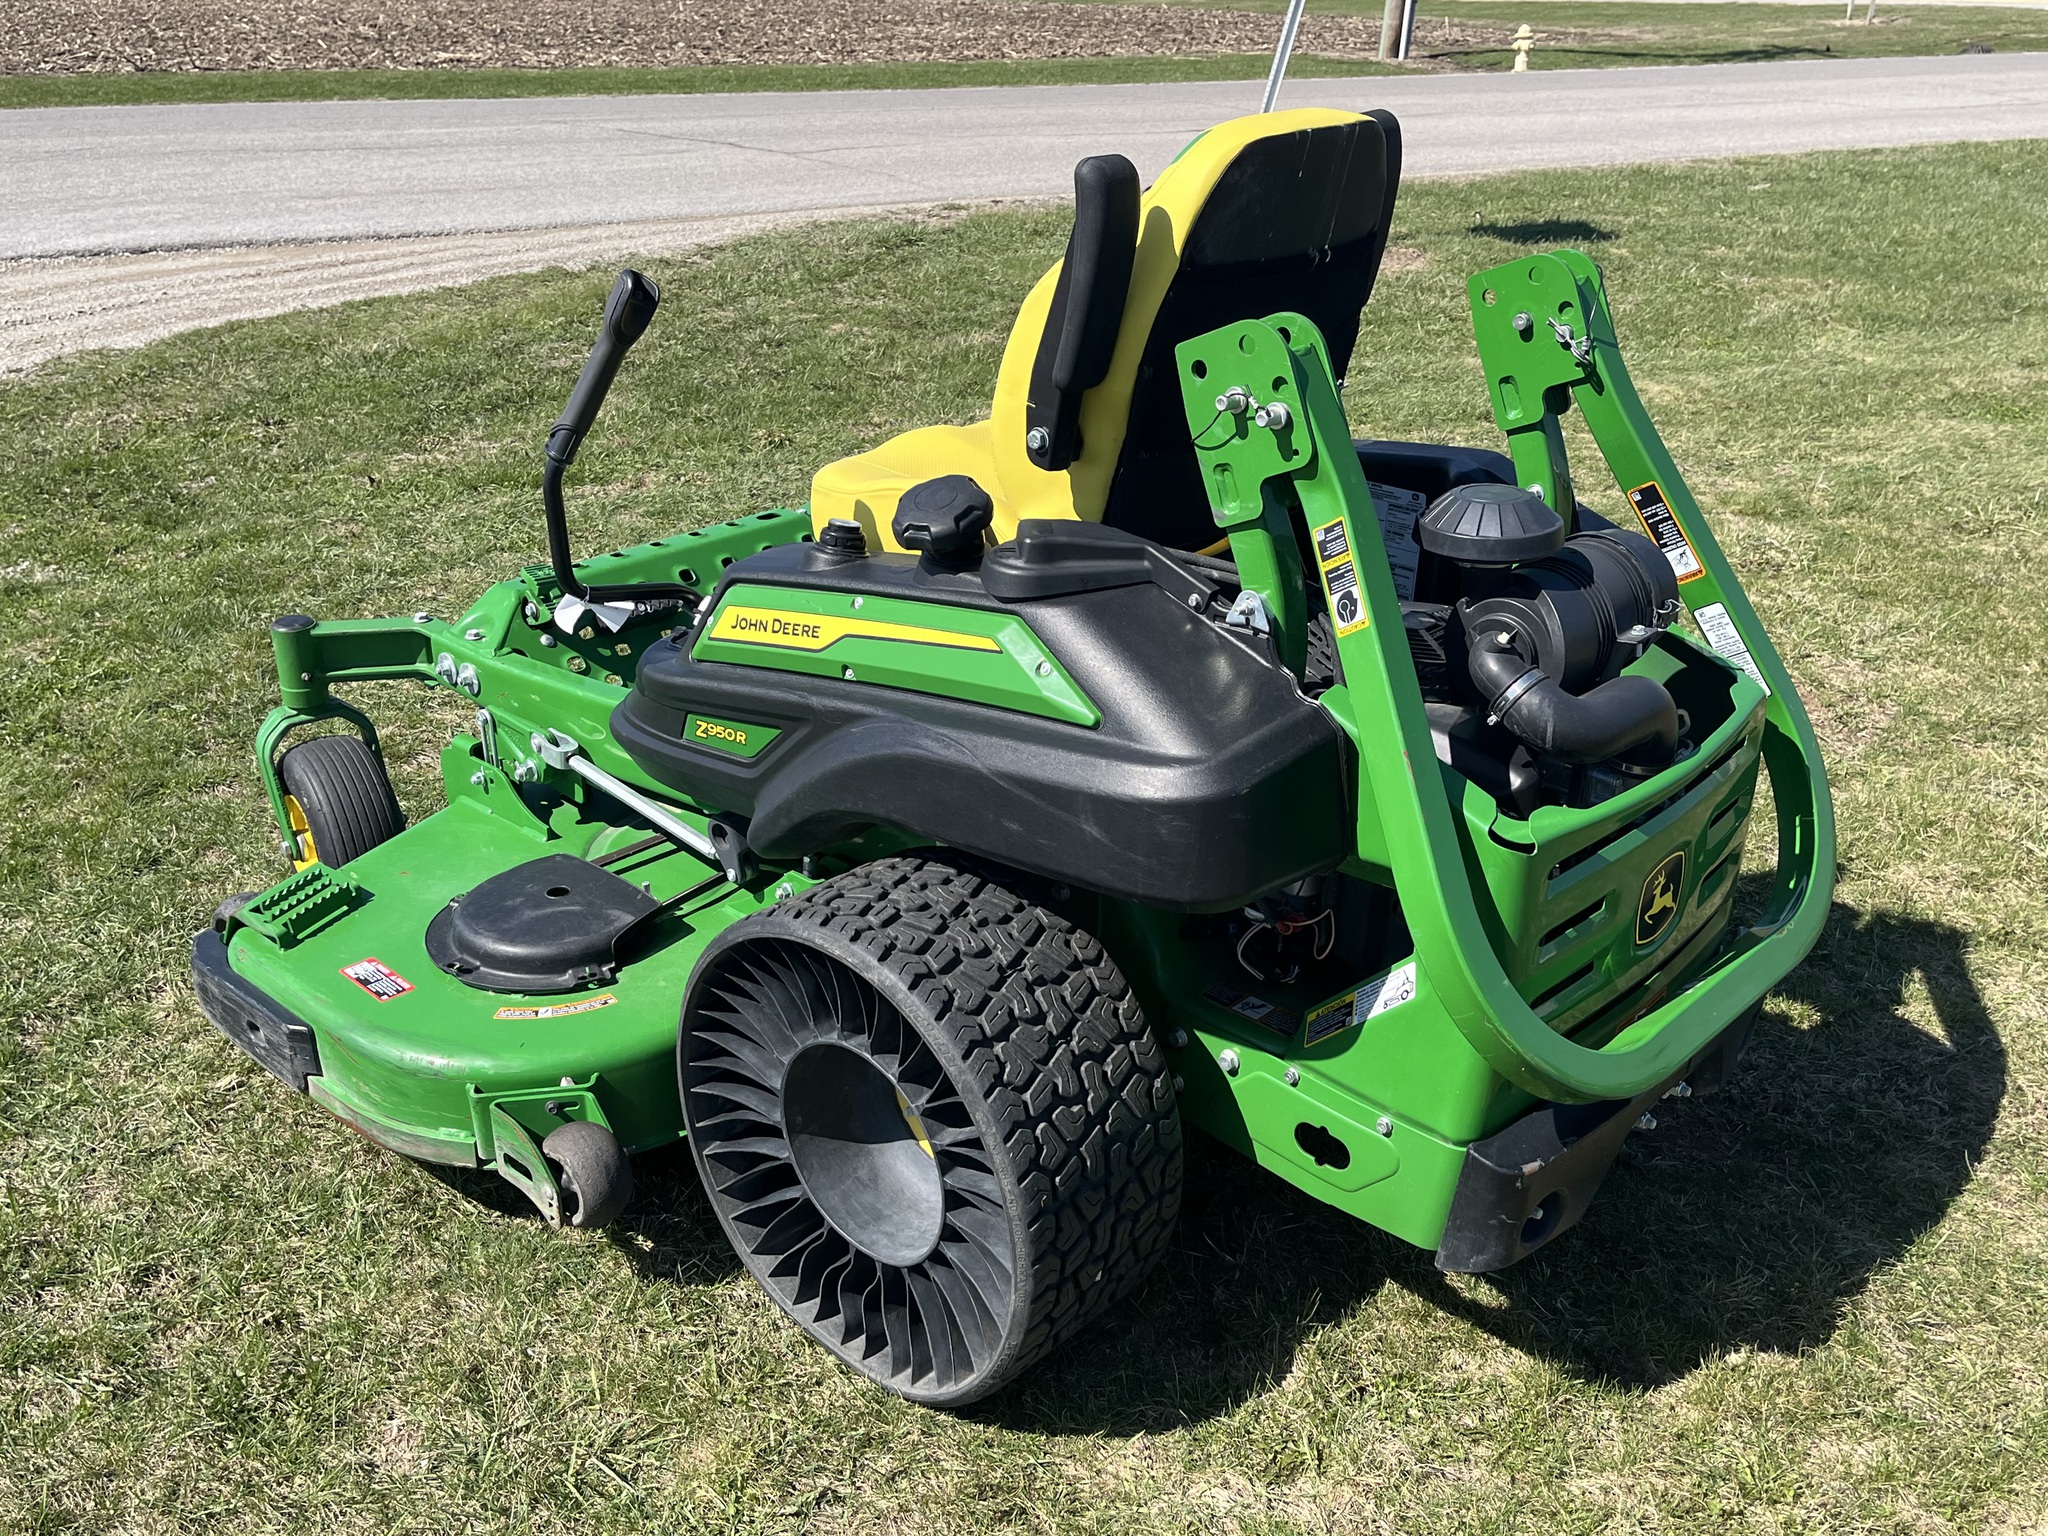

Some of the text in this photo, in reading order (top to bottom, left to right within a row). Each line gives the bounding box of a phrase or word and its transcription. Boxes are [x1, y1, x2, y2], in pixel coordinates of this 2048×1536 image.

[731, 614, 821, 639] JOHN DEERE
[695, 719, 747, 746] Z950R
